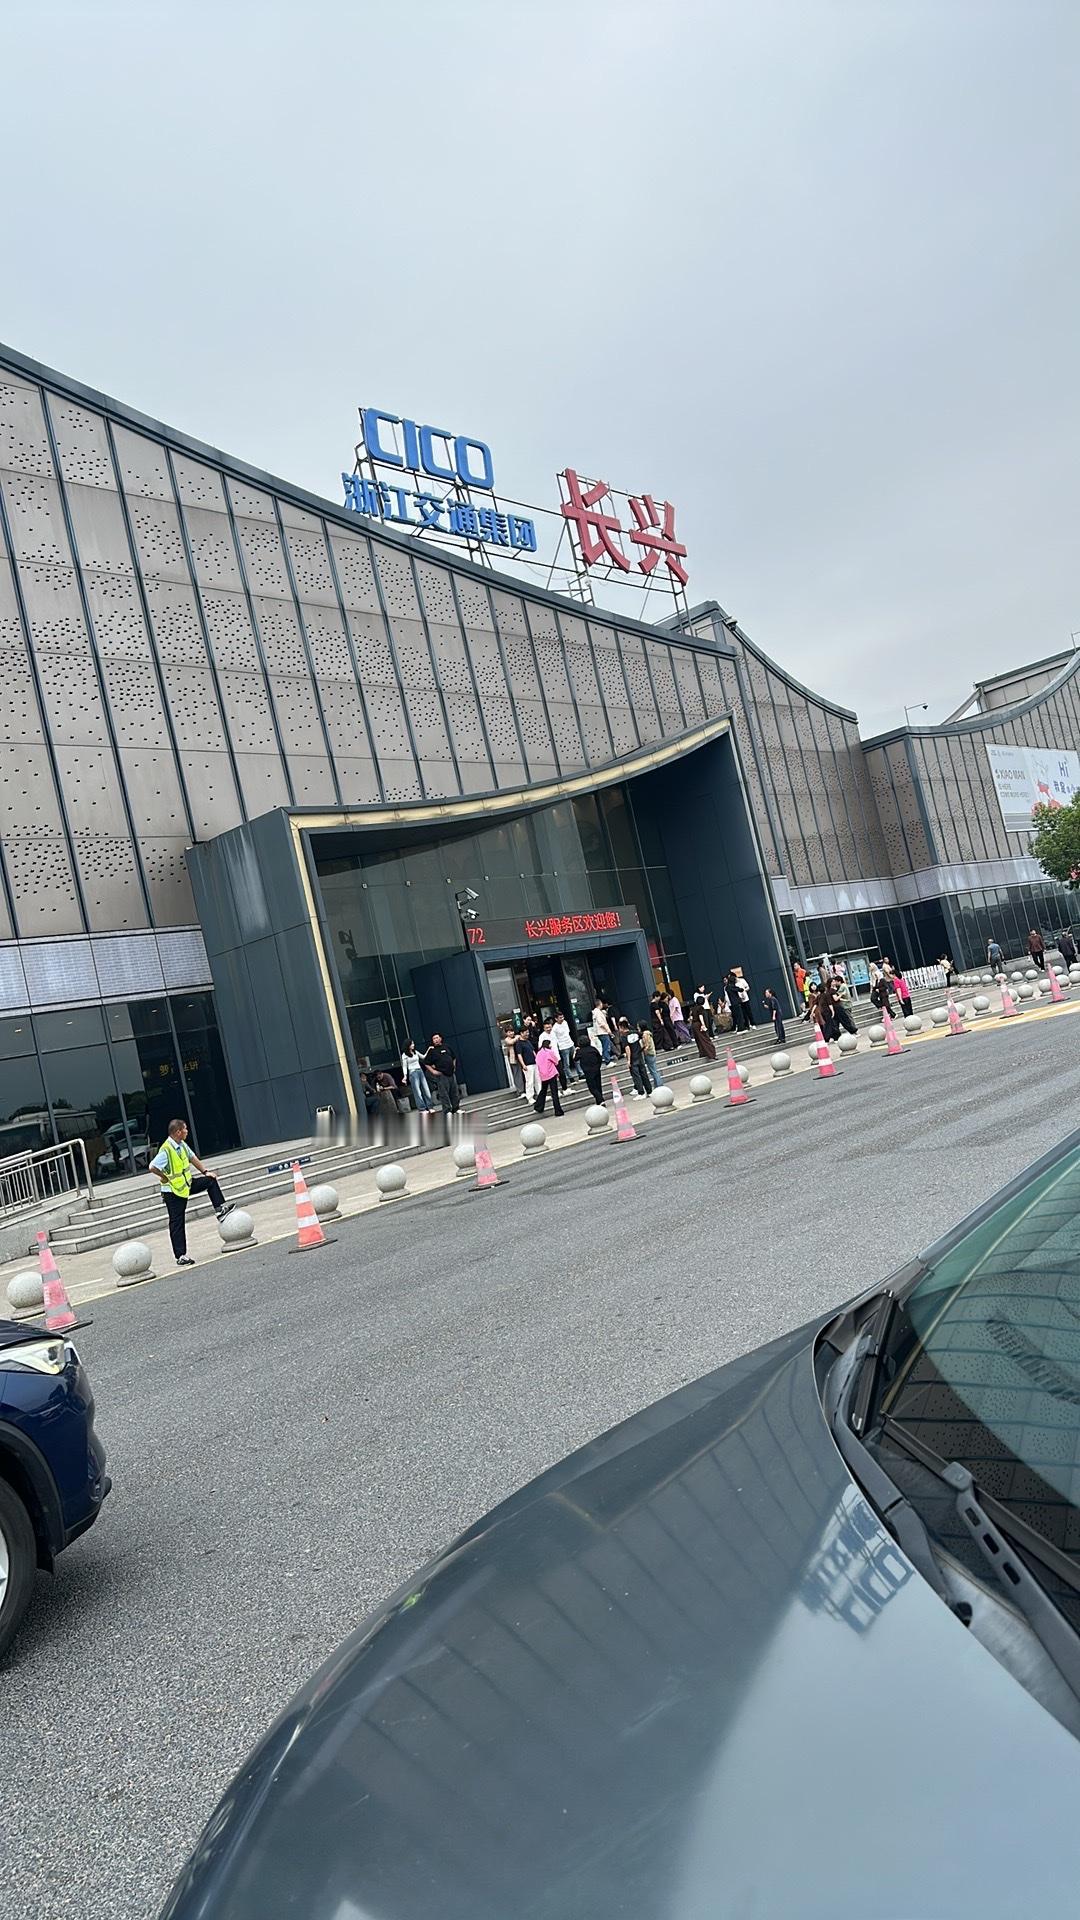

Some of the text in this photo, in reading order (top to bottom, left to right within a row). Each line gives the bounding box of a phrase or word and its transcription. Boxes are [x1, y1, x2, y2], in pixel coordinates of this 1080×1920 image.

[364, 408, 495, 490] CICO
[341, 472, 537, 552] 浙江交通集团
[560, 467, 690, 586] 长兴
[467, 927, 486, 944] 72
[525, 911, 622, 938] 长兴服务区欢迎您!
